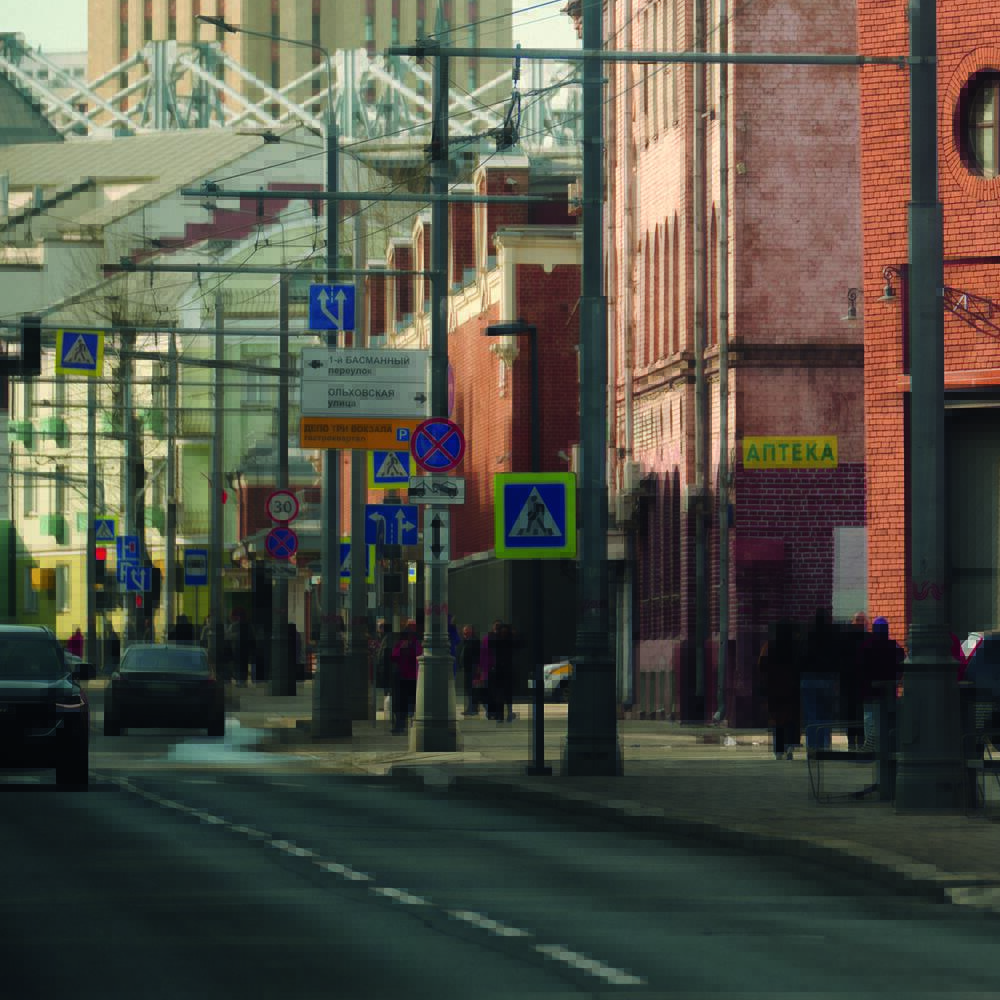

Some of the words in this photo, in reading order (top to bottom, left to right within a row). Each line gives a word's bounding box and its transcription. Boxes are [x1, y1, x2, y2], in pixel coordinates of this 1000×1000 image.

[345, 355, 410, 365] БАСМАННЫЙ
[328, 368, 372, 376] переулок
[328, 388, 395, 398] ОЛЬХОВСКАЯ
[328, 399, 356, 408] улица
[746, 443, 834, 461] АПТЕКА
[273, 500, 292, 513] 30
